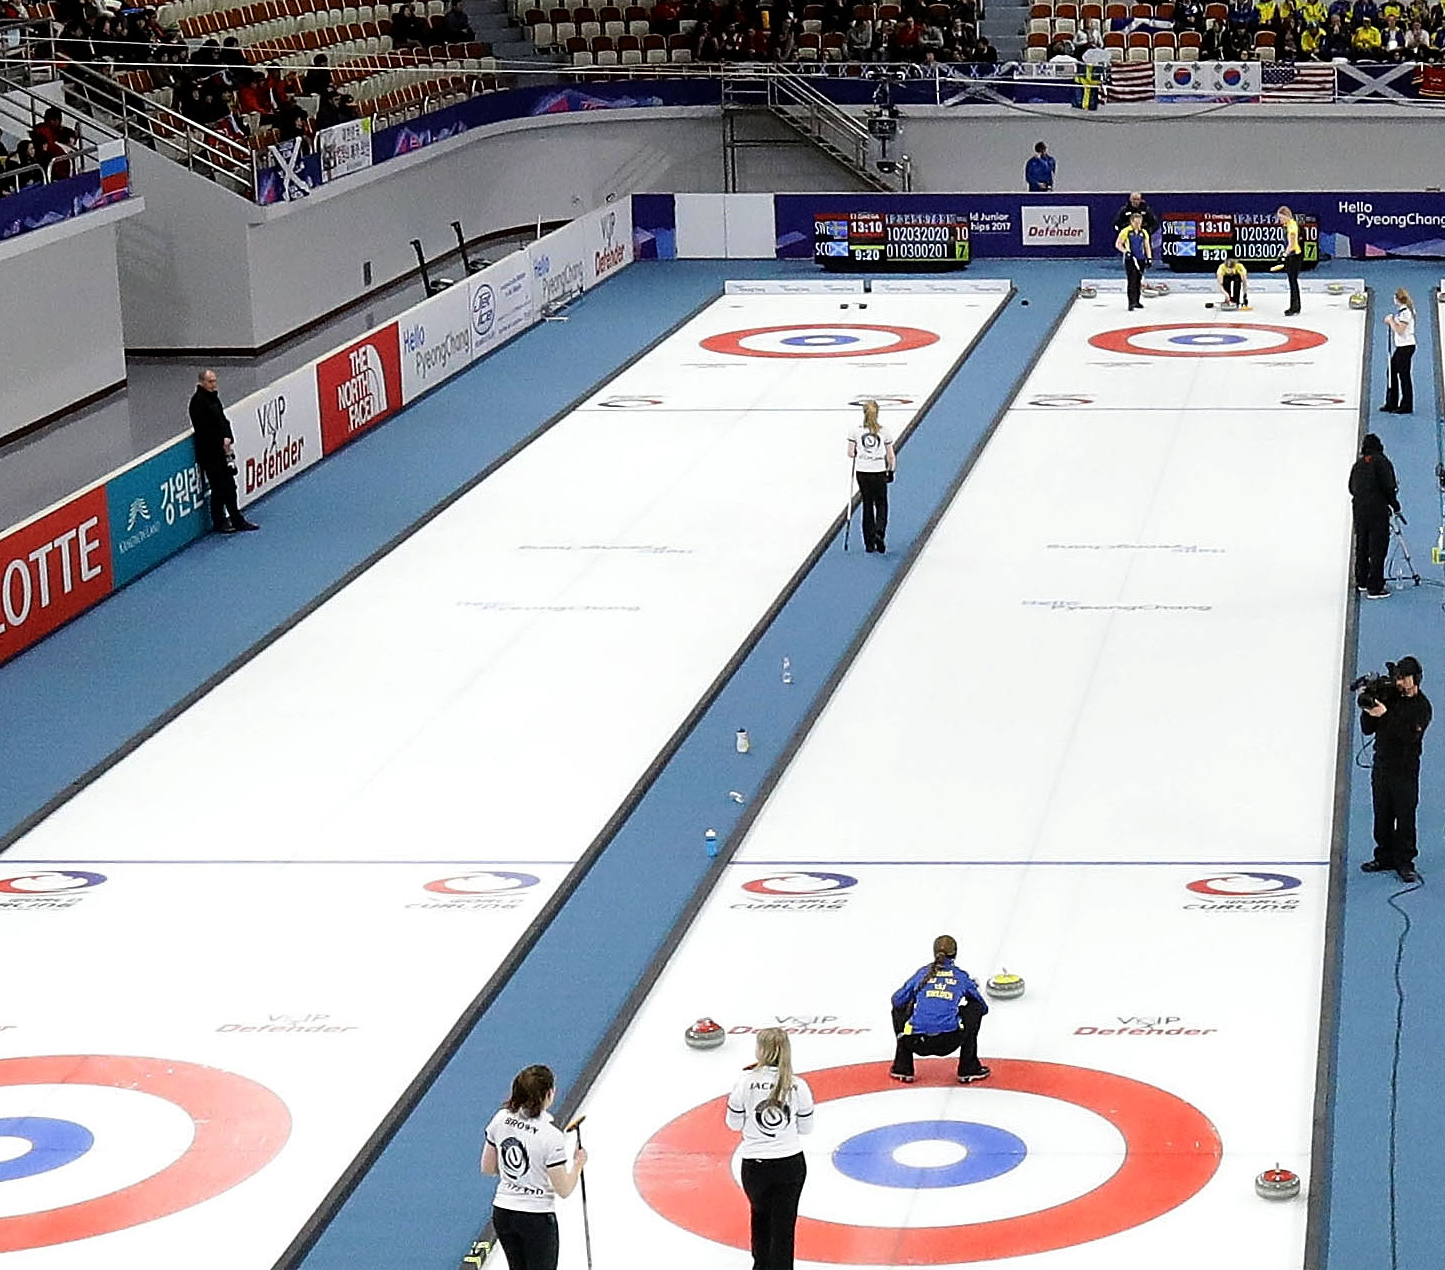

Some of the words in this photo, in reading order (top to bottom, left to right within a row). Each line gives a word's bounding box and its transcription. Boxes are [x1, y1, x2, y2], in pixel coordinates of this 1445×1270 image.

[1338, 200, 1373, 213] Hello
[979, 212, 1009, 221] Junior
[850, 220, 883, 233] 13:10
[991, 222, 1011, 231] 2017
[1027, 225, 1084, 240] Defender
[1199, 221, 1231, 233] 13:10
[854, 249, 881, 261] 9:20
[1202, 250, 1228, 261] 9:20
[403, 323, 426, 353] Hello
[348, 342, 369, 373] THE
[416, 328, 471, 379] PyeongChang
[337, 370, 370, 411] NORTH
[348, 401, 373, 432] FACE
[245, 434, 305, 494] Defender
[1074, 1025, 1219, 1037] Defender
